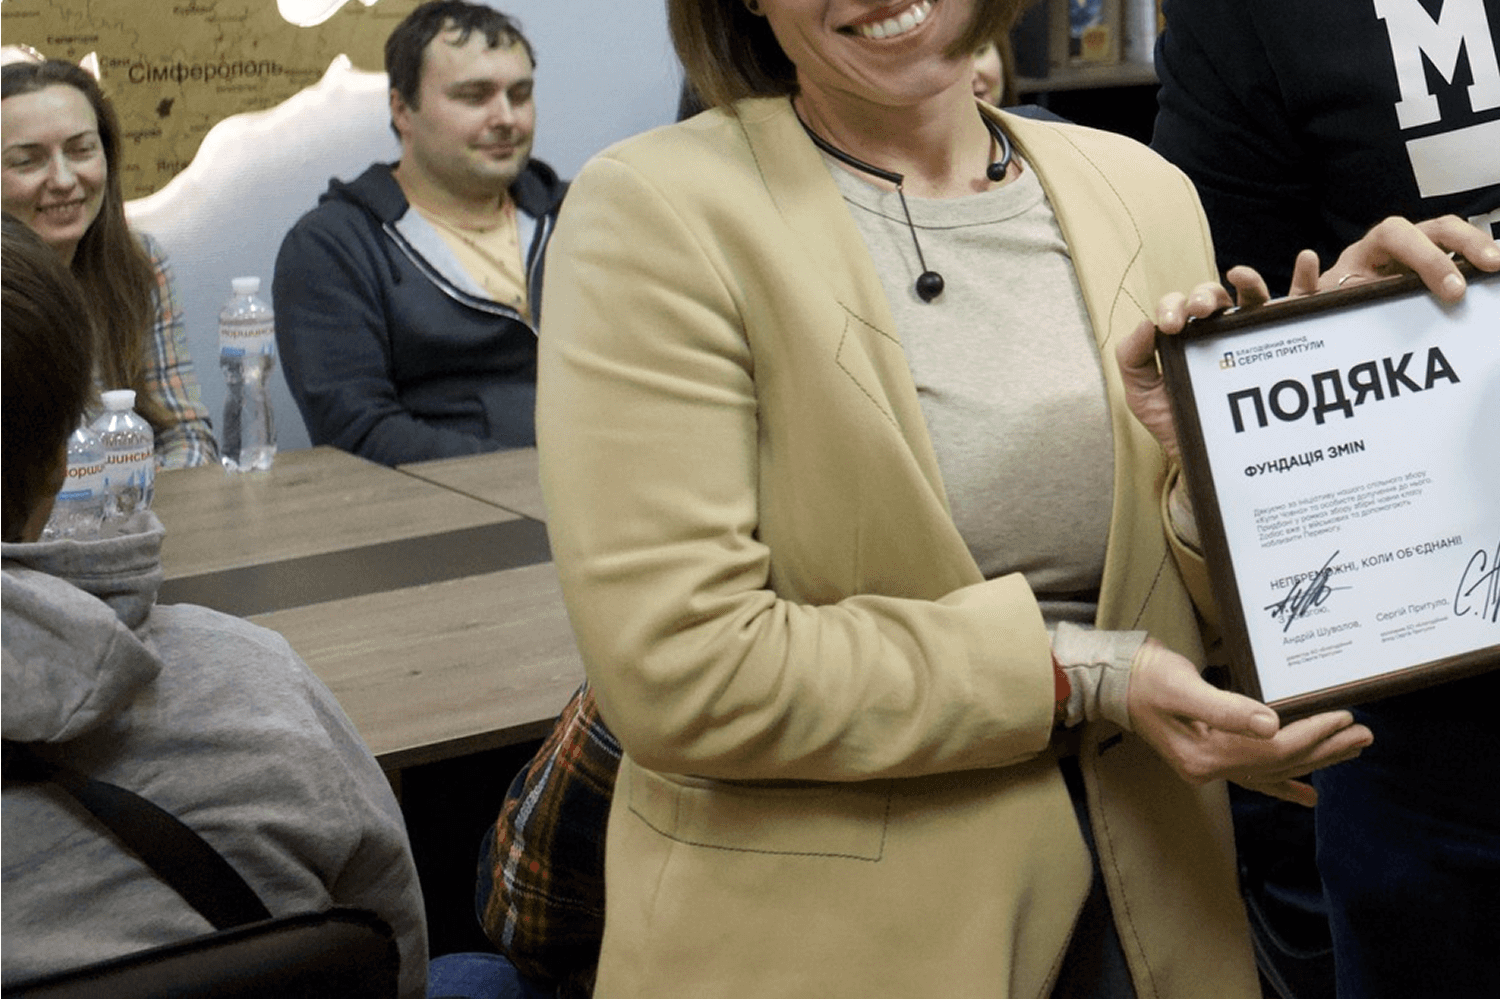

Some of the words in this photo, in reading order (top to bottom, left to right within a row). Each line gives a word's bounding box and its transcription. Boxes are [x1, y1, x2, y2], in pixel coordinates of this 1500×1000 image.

[128, 58, 283, 86] Сімферополь
[1238, 351, 1273, 366] СЕРГІЯ
[1275, 340, 1324, 357] ПРИТУЛИ
[1227, 346, 1461, 434] ПОДЯКА
[1244, 449, 1324, 477] ФУНДАЦІЯ
[1361, 552, 1394, 568] КОЛИ
[1375, 607, 1407, 622] Сергій
